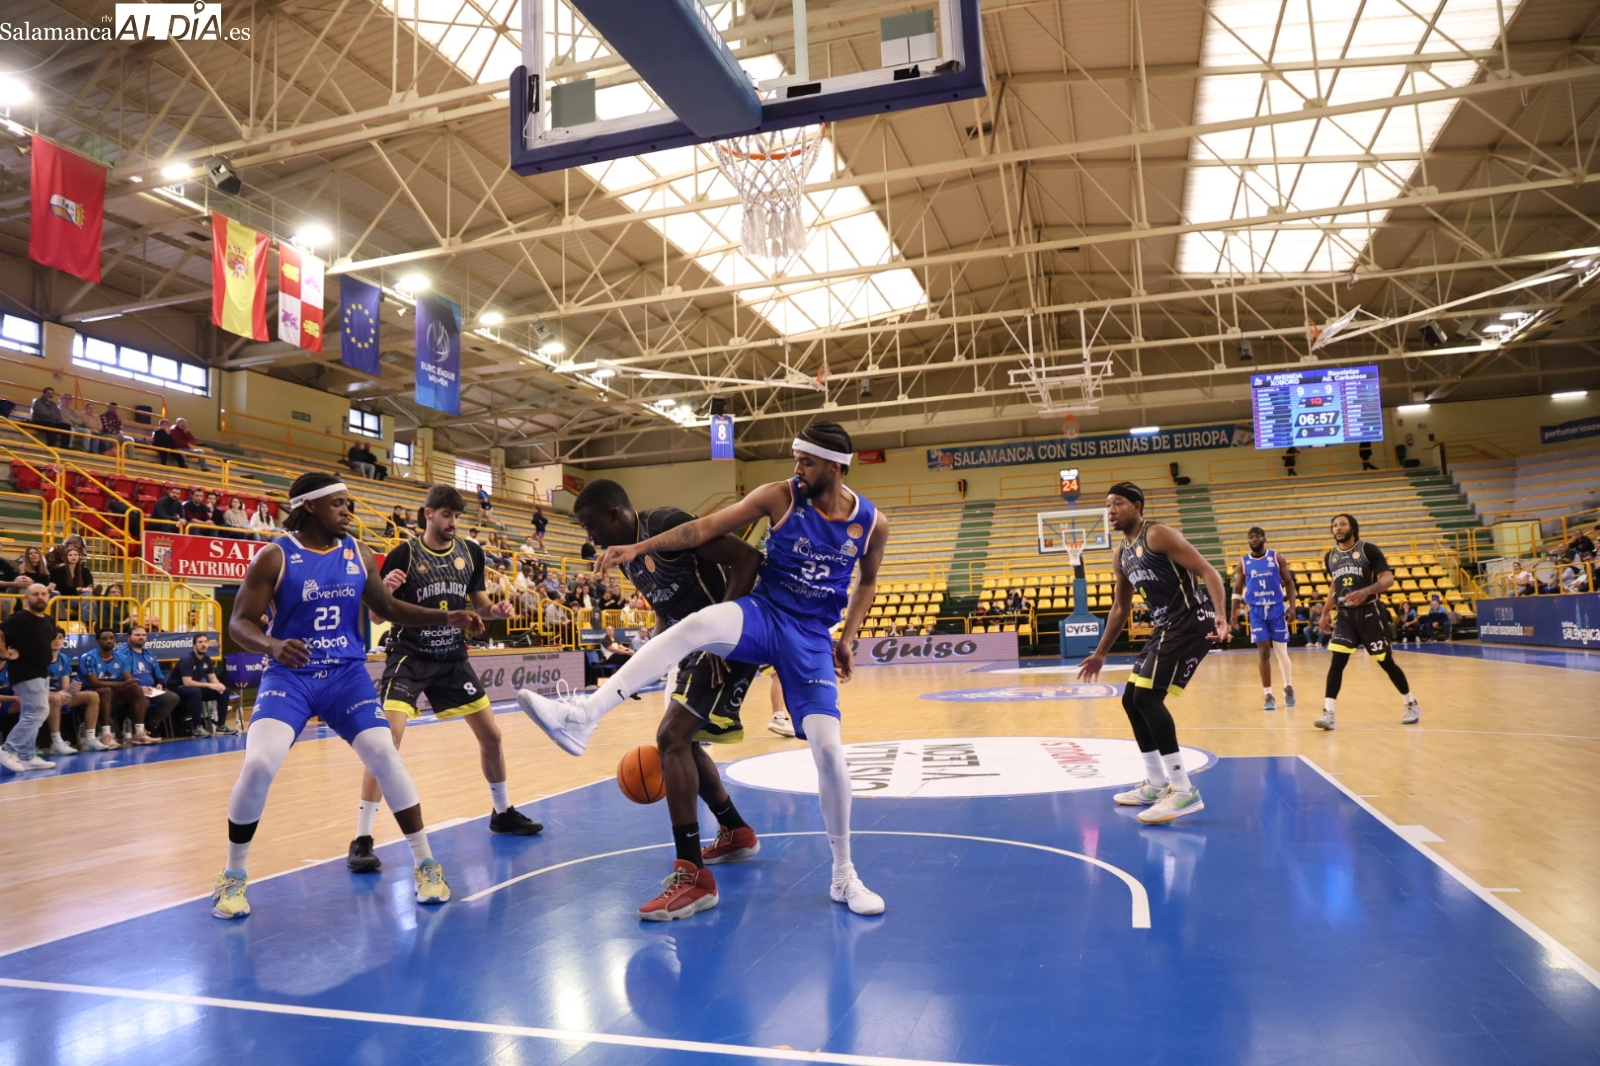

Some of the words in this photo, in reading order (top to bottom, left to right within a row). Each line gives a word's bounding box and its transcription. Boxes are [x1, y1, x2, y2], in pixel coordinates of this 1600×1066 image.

[420, 361, 456, 381] EUROEAGUE
[1273, 373, 1303, 381] AVENIDA
[1327, 369, 1359, 377] Recoletas
[1270, 379, 1300, 387] XOBORG
[1325, 384, 1333, 394] 9
[1296, 386, 1305, 397] 9
[1298, 412, 1336, 426] 06:57
[717, 424, 727, 441] 8
[1301, 429, 1308, 437] 0
[1329, 427, 1335, 435] 3
[953, 445, 1036, 467] SALAMANCA
[1037, 443, 1067, 460] CON
[1069, 440, 1097, 458] SUS
[1099, 436, 1151, 455] REINAS
[1152, 434, 1171, 450] DE
[1174, 429, 1230, 448] EUROPA
[1062, 480, 1079, 492] 24
[799, 545, 848, 566] avenida
[1332, 564, 1363, 581] CARBAJOSA
[1259, 579, 1266, 590] 4
[1342, 577, 1353, 587] 32
[308, 586, 356, 601] avenida
[416, 581, 467, 603] CARBAJOSA
[313, 605, 341, 632] 23
[430, 638, 454, 647] salud
[1370, 640, 1384, 652] 32
[871, 636, 977, 663] Guiso
[511, 664, 561, 691] Guiso
[463, 681, 478, 696] 8
